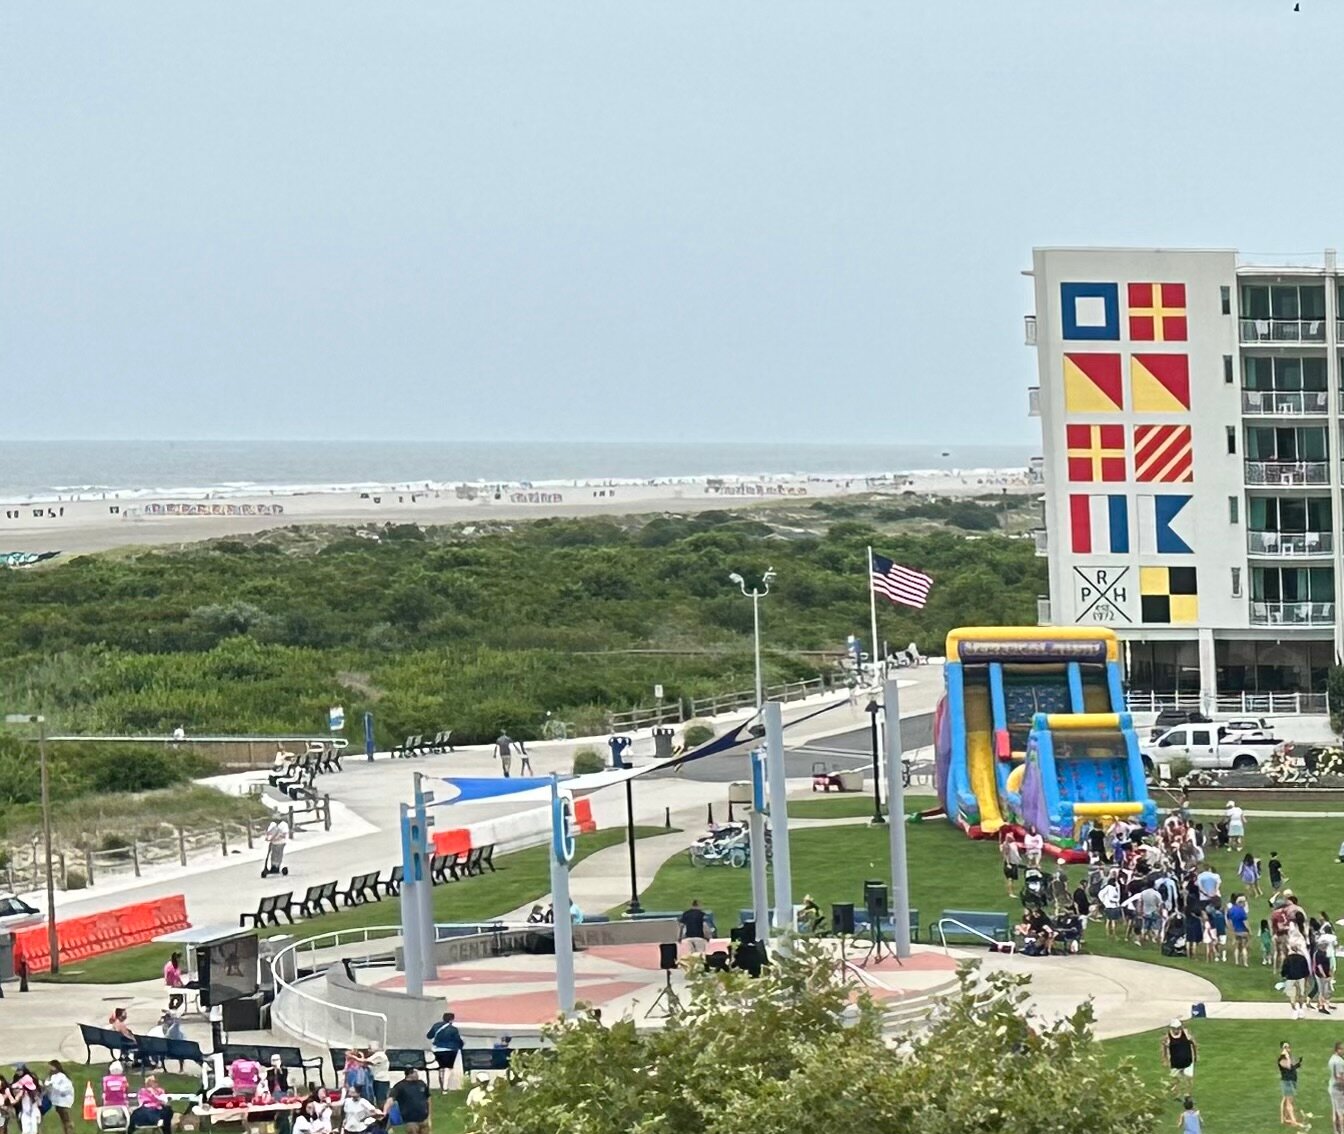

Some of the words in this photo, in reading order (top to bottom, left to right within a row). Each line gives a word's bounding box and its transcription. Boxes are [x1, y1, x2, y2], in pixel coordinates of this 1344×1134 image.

[1097, 570, 1107, 585] R
[1081, 587, 1091, 602] P
[1113, 587, 1126, 602] H
